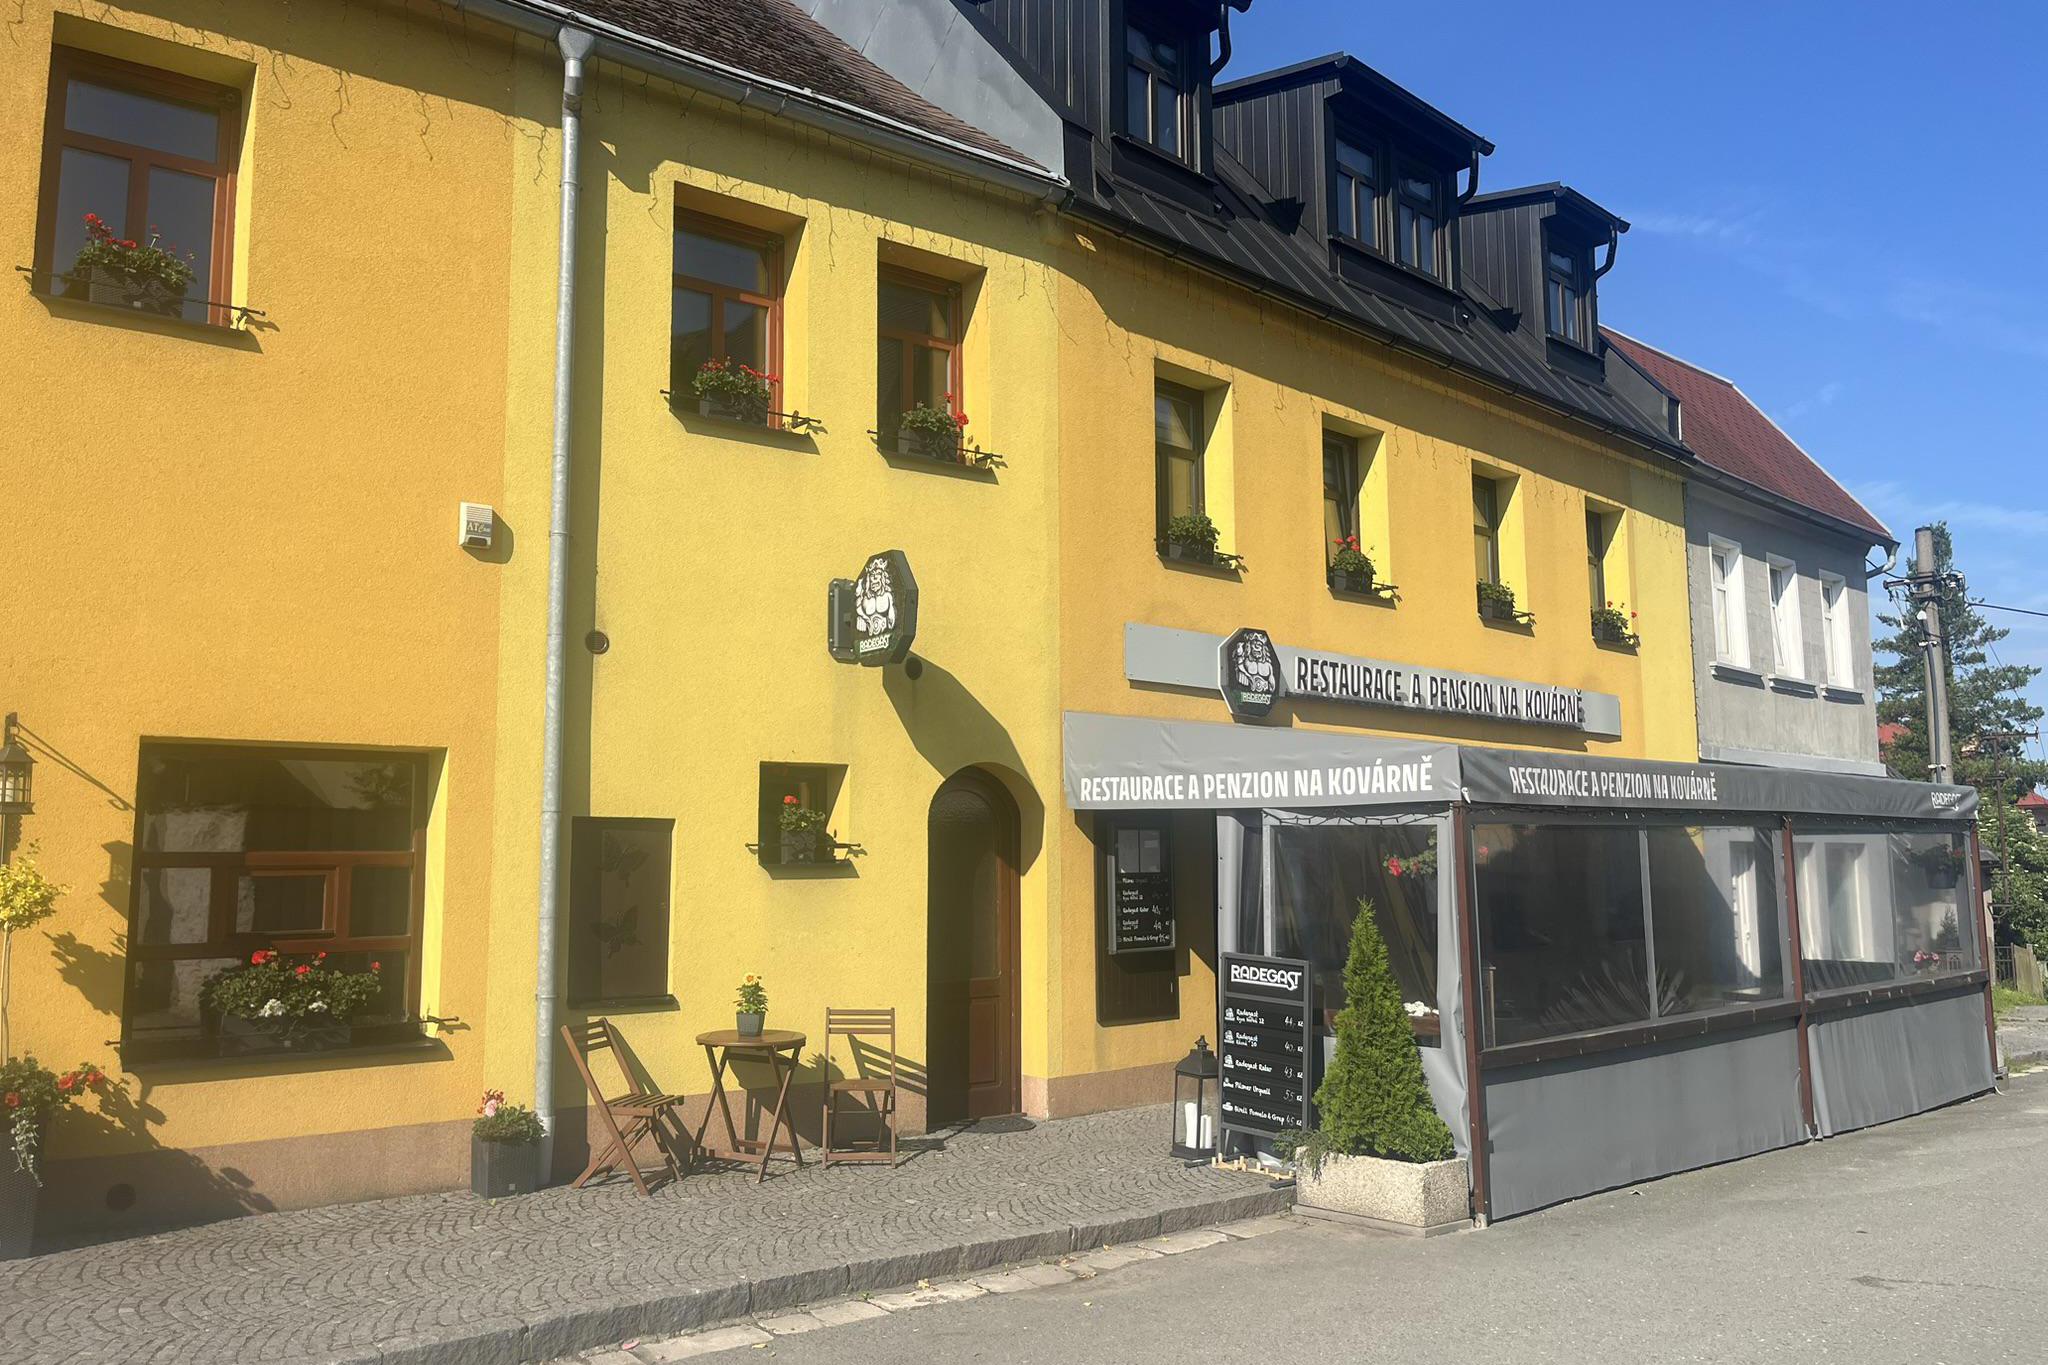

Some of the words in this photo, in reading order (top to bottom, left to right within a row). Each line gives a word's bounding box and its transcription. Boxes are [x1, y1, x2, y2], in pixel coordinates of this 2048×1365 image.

[1295, 656, 1402, 701] RESTAURACE
[1411, 673, 1421, 704] A
[1427, 676, 1494, 713] PENSION
[1498, 685, 1518, 716] NA
[1523, 685, 1583, 723] KOVÁRNĚ
[1080, 774, 1185, 802] RESTAURACE
[1188, 774, 1200, 800] A
[1203, 769, 1289, 800] PENZION
[1294, 768, 1324, 797] NA
[1328, 755, 1433, 796] KOVÁRNĚ
[1508, 766, 1589, 797] RESTAURACE
[1591, 771, 1600, 797] A
[1600, 771, 1652, 799] PENZION
[1653, 774, 1669, 800] NA
[1670, 770, 1718, 801] KOVÁRNĚ
[1231, 964, 1303, 991] RADEGAST
